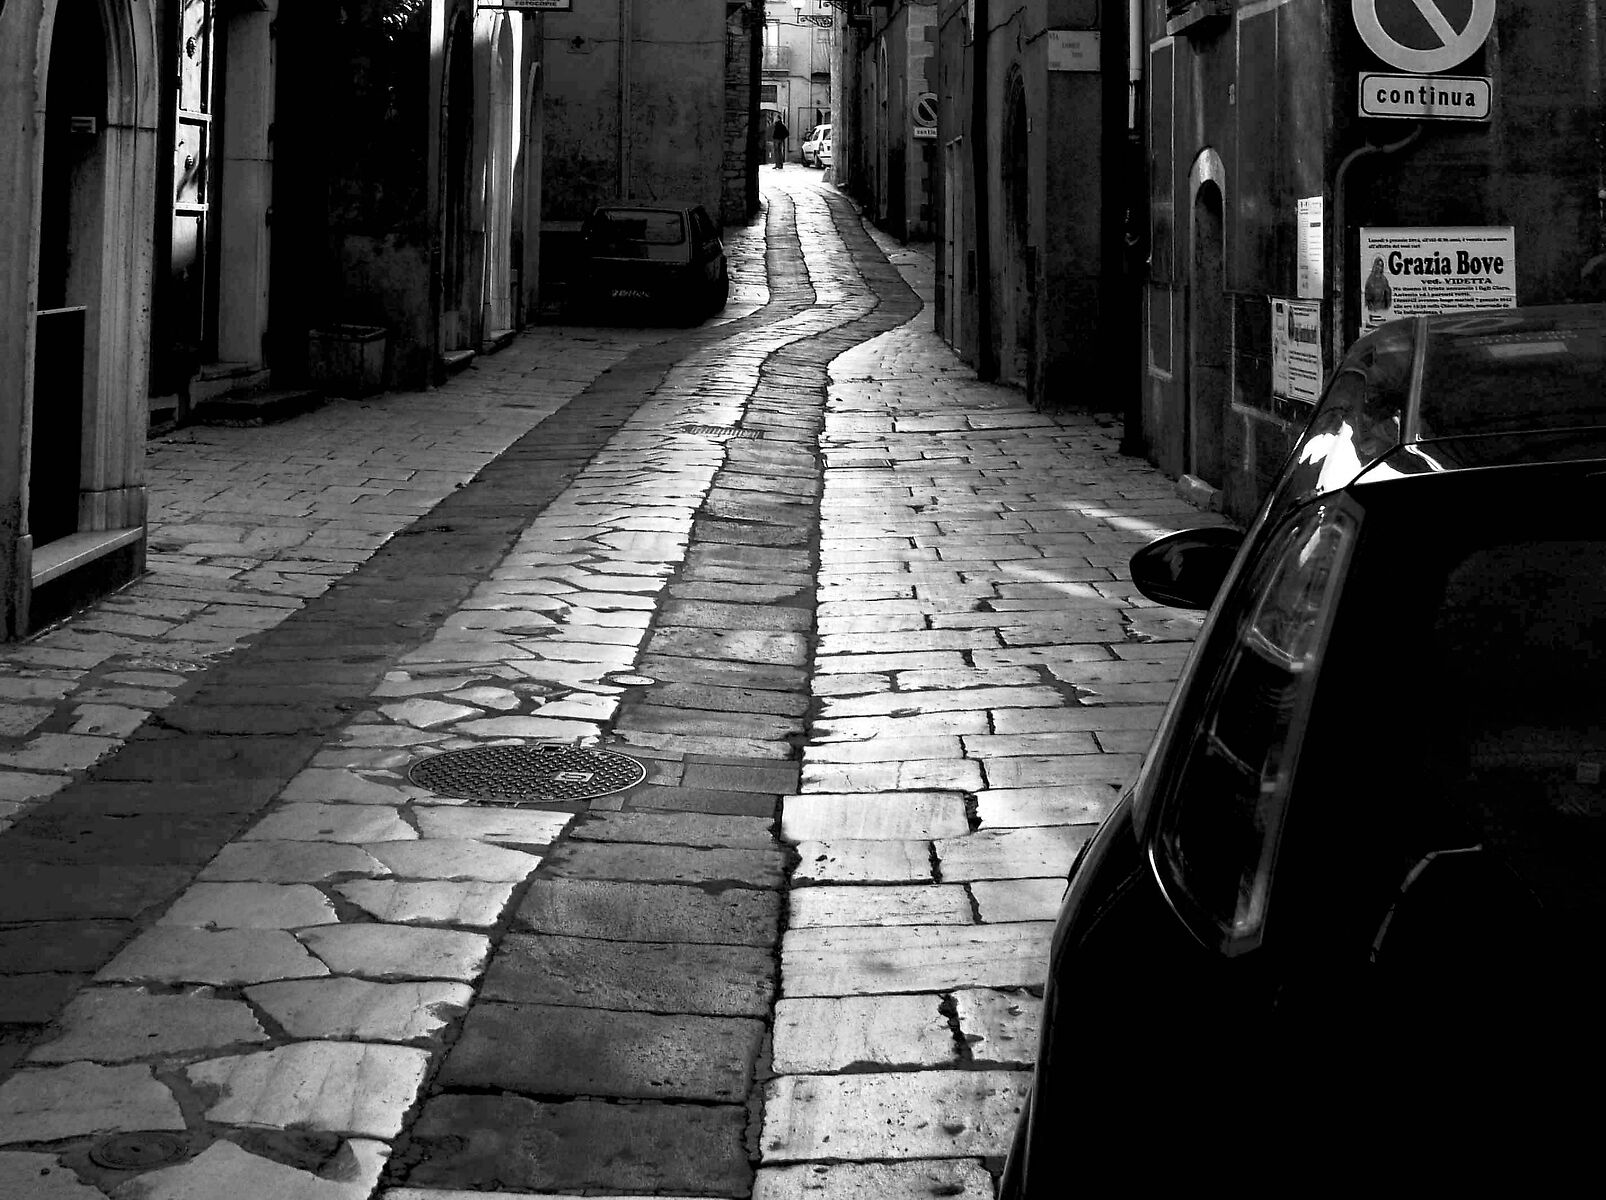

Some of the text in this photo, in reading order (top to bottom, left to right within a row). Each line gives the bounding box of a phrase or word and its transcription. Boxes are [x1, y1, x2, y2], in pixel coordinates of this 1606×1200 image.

[1376, 86, 1476, 107] continua
[1388, 250, 1504, 275] Grazia Bove
[1444, 277, 1493, 285] VIDETTA
